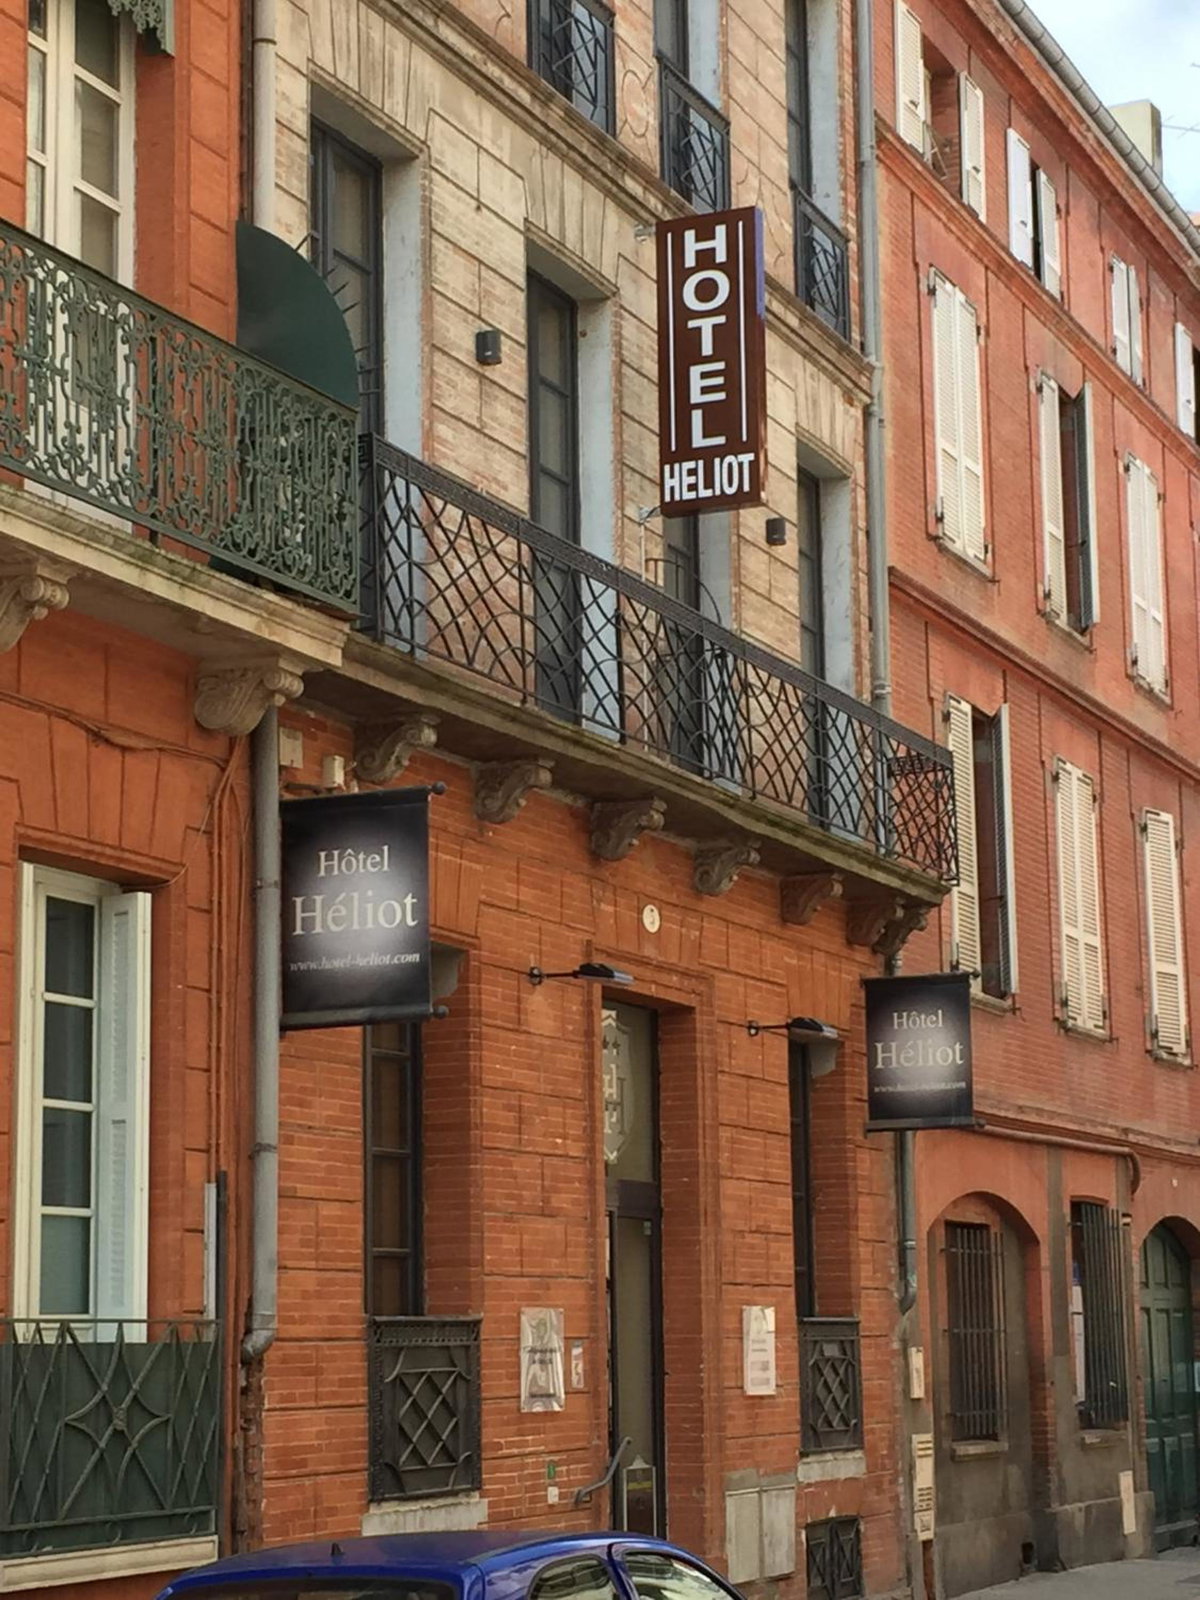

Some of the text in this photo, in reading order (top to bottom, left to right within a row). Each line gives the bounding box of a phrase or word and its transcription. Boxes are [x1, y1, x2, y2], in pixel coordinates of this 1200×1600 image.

[682, 224, 730, 449] HOTEL
[663, 453, 755, 502] HELIOT
[318, 844, 390, 877] Hôtel
[292, 889, 419, 936] Héliot
[893, 1009, 944, 1030] Hôtel
[874, 1039, 965, 1069] Héliot
